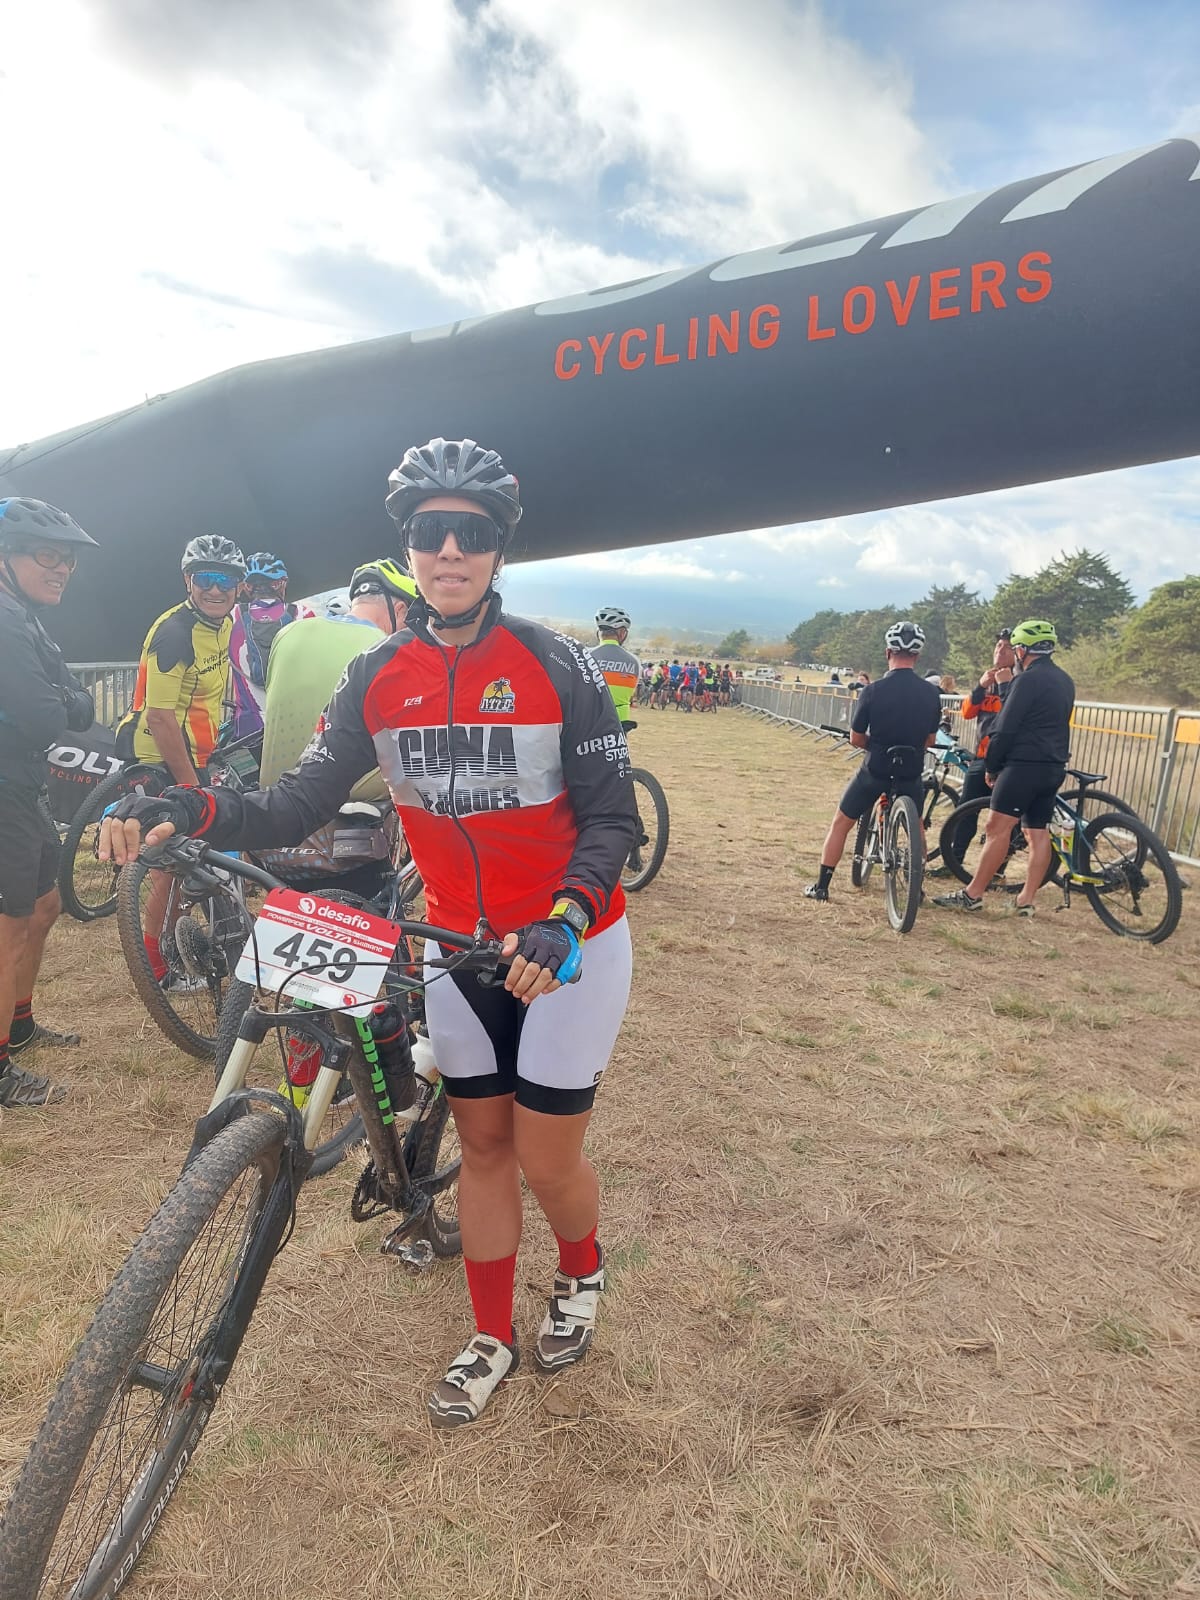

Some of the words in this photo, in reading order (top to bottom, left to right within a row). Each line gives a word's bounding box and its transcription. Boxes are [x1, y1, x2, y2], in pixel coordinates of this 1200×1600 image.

[553, 304, 781, 380] CYCLING
[806, 251, 1054, 342] LOVERS
[597, 659, 636, 674] ERONA
[576, 732, 628, 756] URBA
[44, 743, 125, 775] OLT
[49, 766, 92, 785] YCLING
[306, 923, 352, 945] VOLTA
[273, 932, 358, 984] 459
